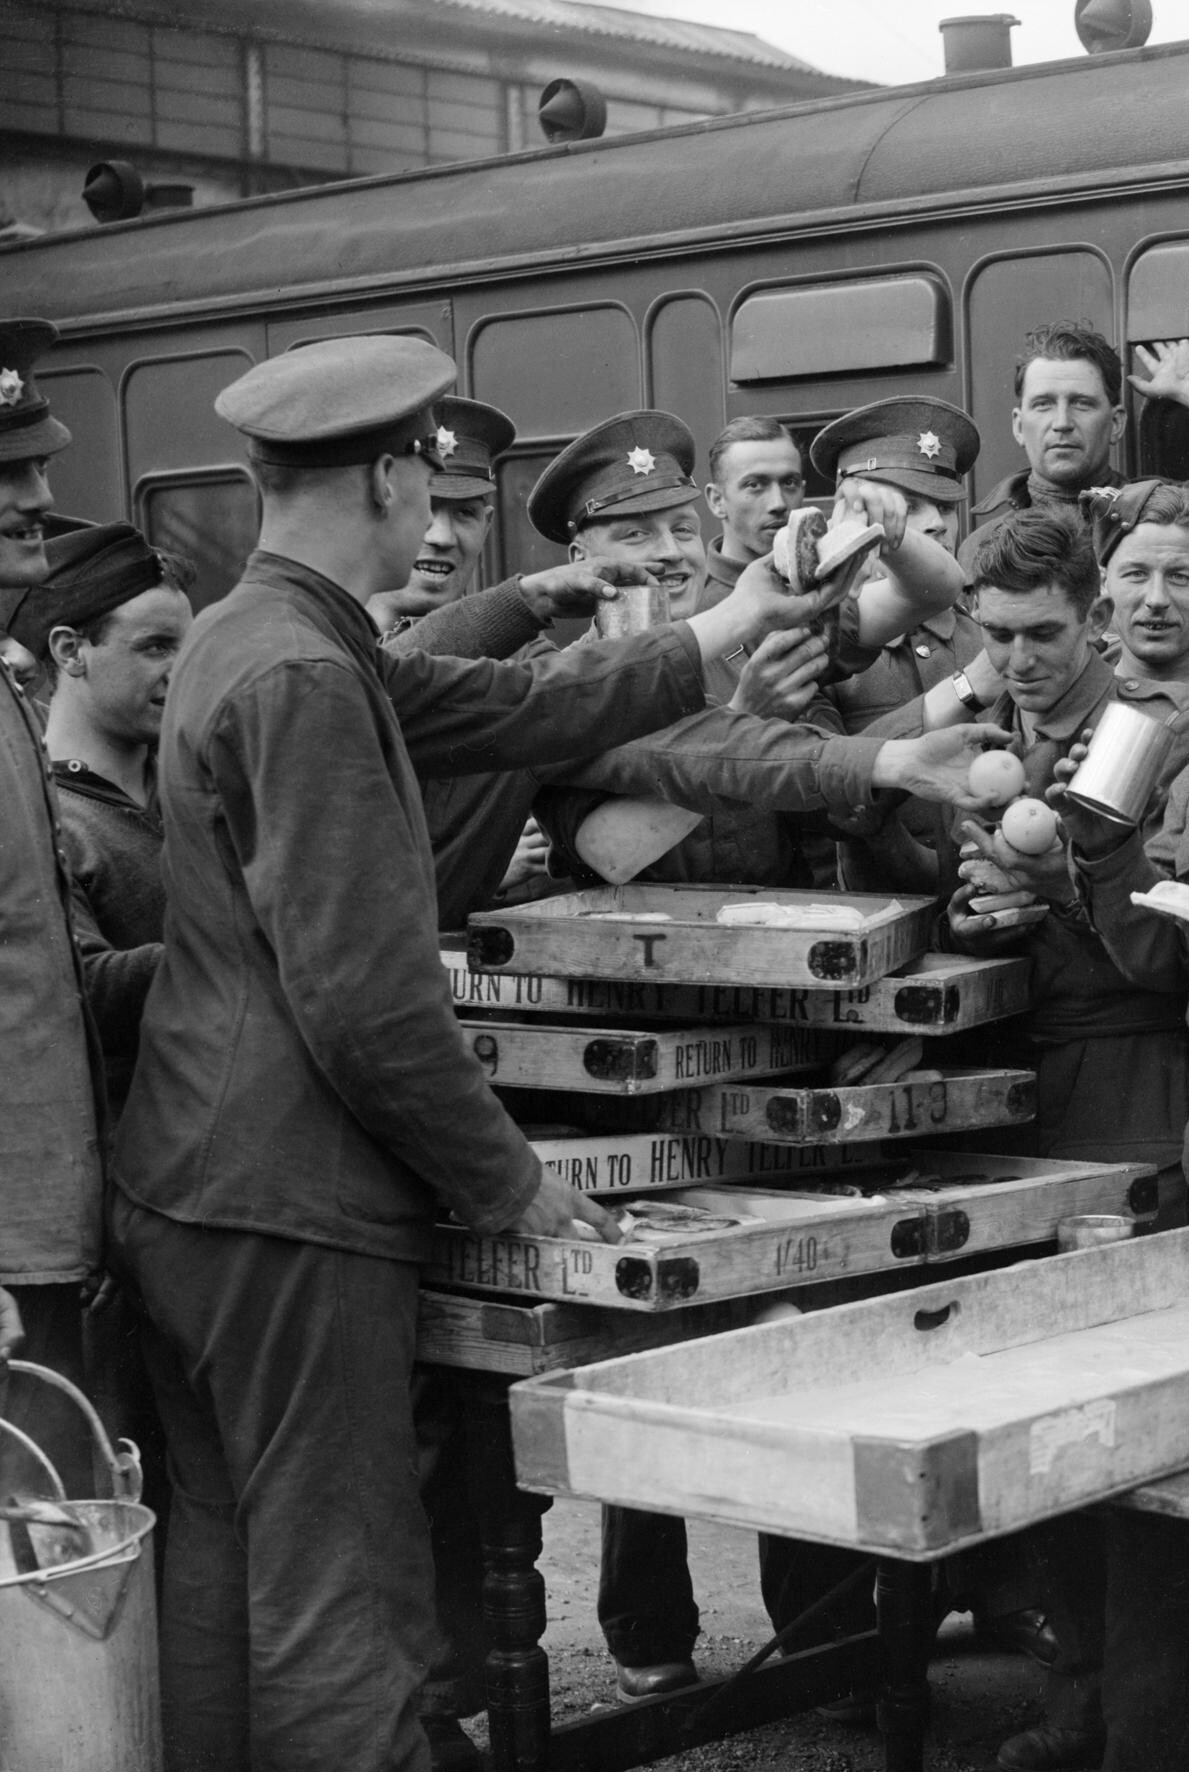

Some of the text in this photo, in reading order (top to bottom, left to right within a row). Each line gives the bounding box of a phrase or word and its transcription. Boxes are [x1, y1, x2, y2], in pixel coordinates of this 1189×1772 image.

[632, 933, 668, 968] T
[452, 968, 501, 1003] URN
[512, 976, 543, 1004] TO
[474, 1034, 499, 1078] 9
[675, 1039, 732, 1080] RETURN
[738, 1035, 757, 1070] TO
[606, 1153, 633, 1188] TO
[649, 1136, 731, 1184] HENRY
[446, 1237, 542, 1292] TELFER
